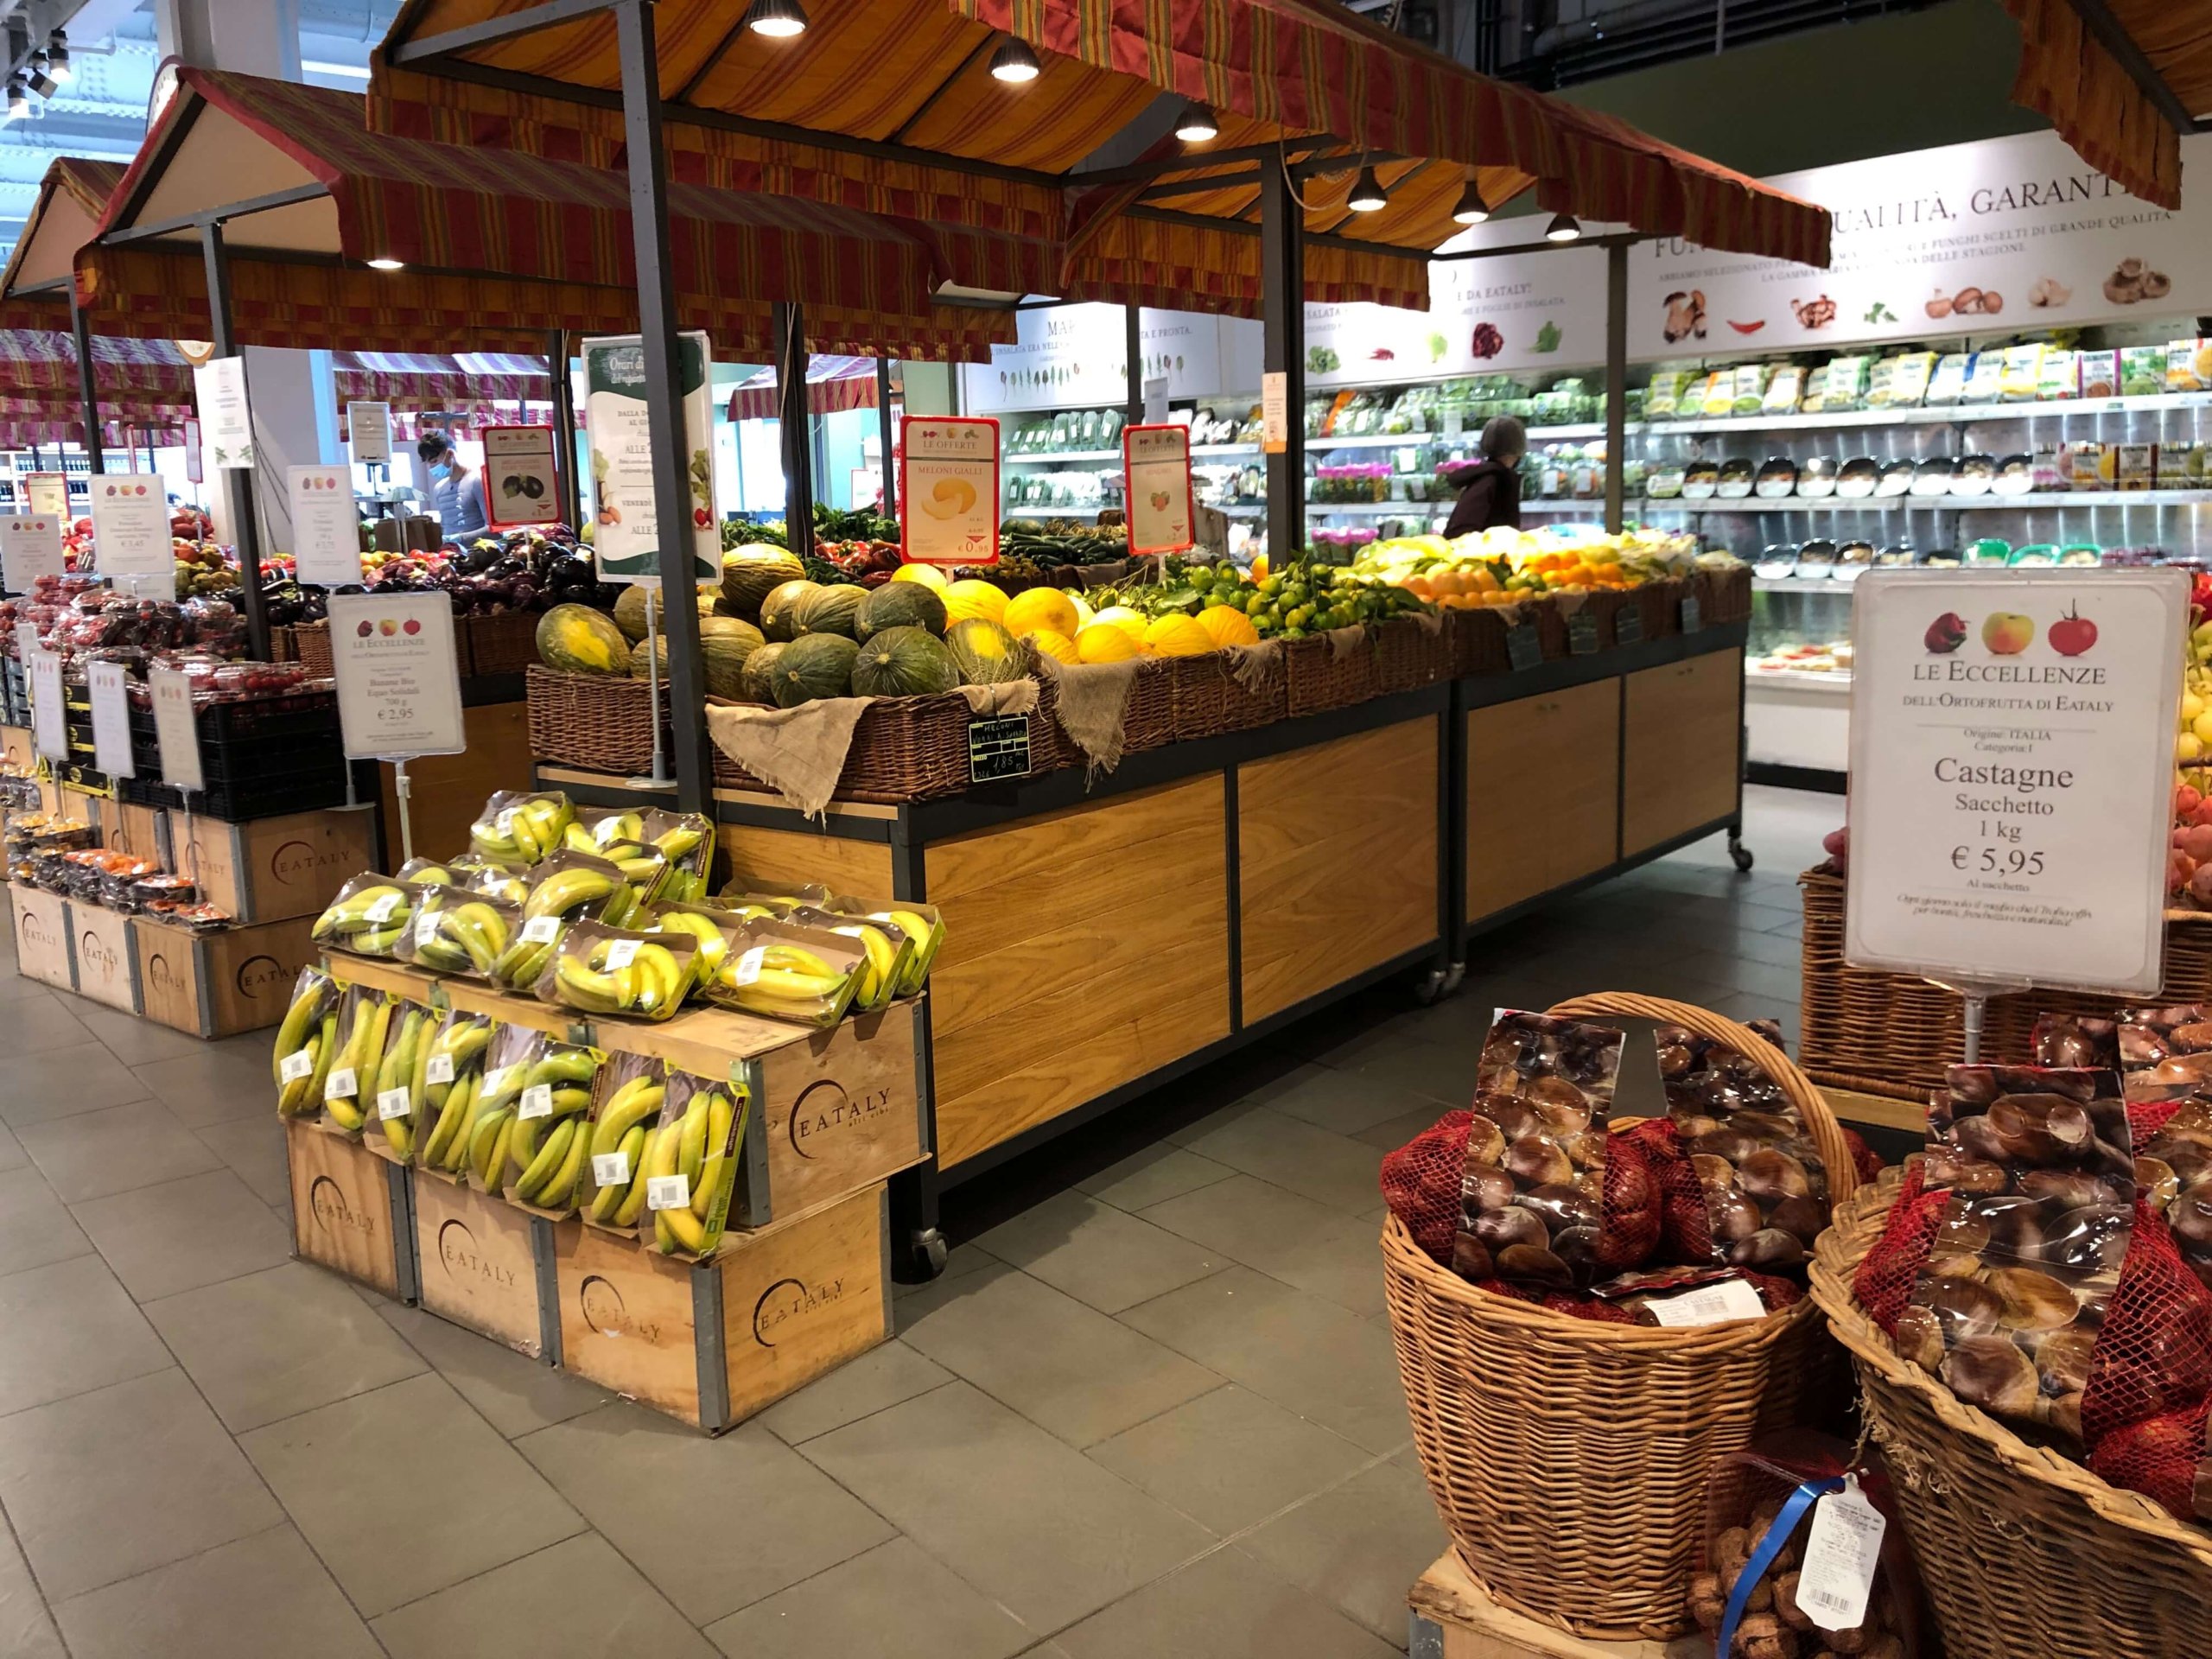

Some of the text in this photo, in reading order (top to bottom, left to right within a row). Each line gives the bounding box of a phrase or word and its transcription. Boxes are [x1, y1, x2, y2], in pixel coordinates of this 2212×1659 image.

[1970, 172, 2132, 216] GARANT
[1983, 228, 2028, 243] SCELTI
[2031, 226, 2046, 237] DI
[2050, 219, 2105, 234] GRANDE
[1961, 242, 2026, 260] STAGIONE
[936, 441, 978, 449] OFFERTE
[366, 639, 426, 648] ECCELLENZE
[1913, 659, 2107, 685] LE ECCELLENZE
[1902, 692, 2114, 713] DELL'ORTOFRUTTA DI EATALY
[377, 709, 385, 720] €
[2009, 730, 2052, 741] ITALIA
[1933, 757, 2075, 794] Castagne
[1955, 792, 2055, 817] Sacchetto
[1980, 820, 2024, 843] 1 kg
[279, 850, 351, 874] EATALY
[1950, 846, 2045, 879] € 5,95
[1966, 878, 2031, 893] Al sacchetto
[25, 927, 57, 947] EATALY
[86, 946, 118, 966] EATALY
[244, 965, 301, 987] EATAL
[799, 1087, 891, 1139] EATALY
[316, 1198, 375, 1232] EATALY
[445, 1244, 517, 1287] EATALY
[760, 1277, 844, 1332] EATALY
